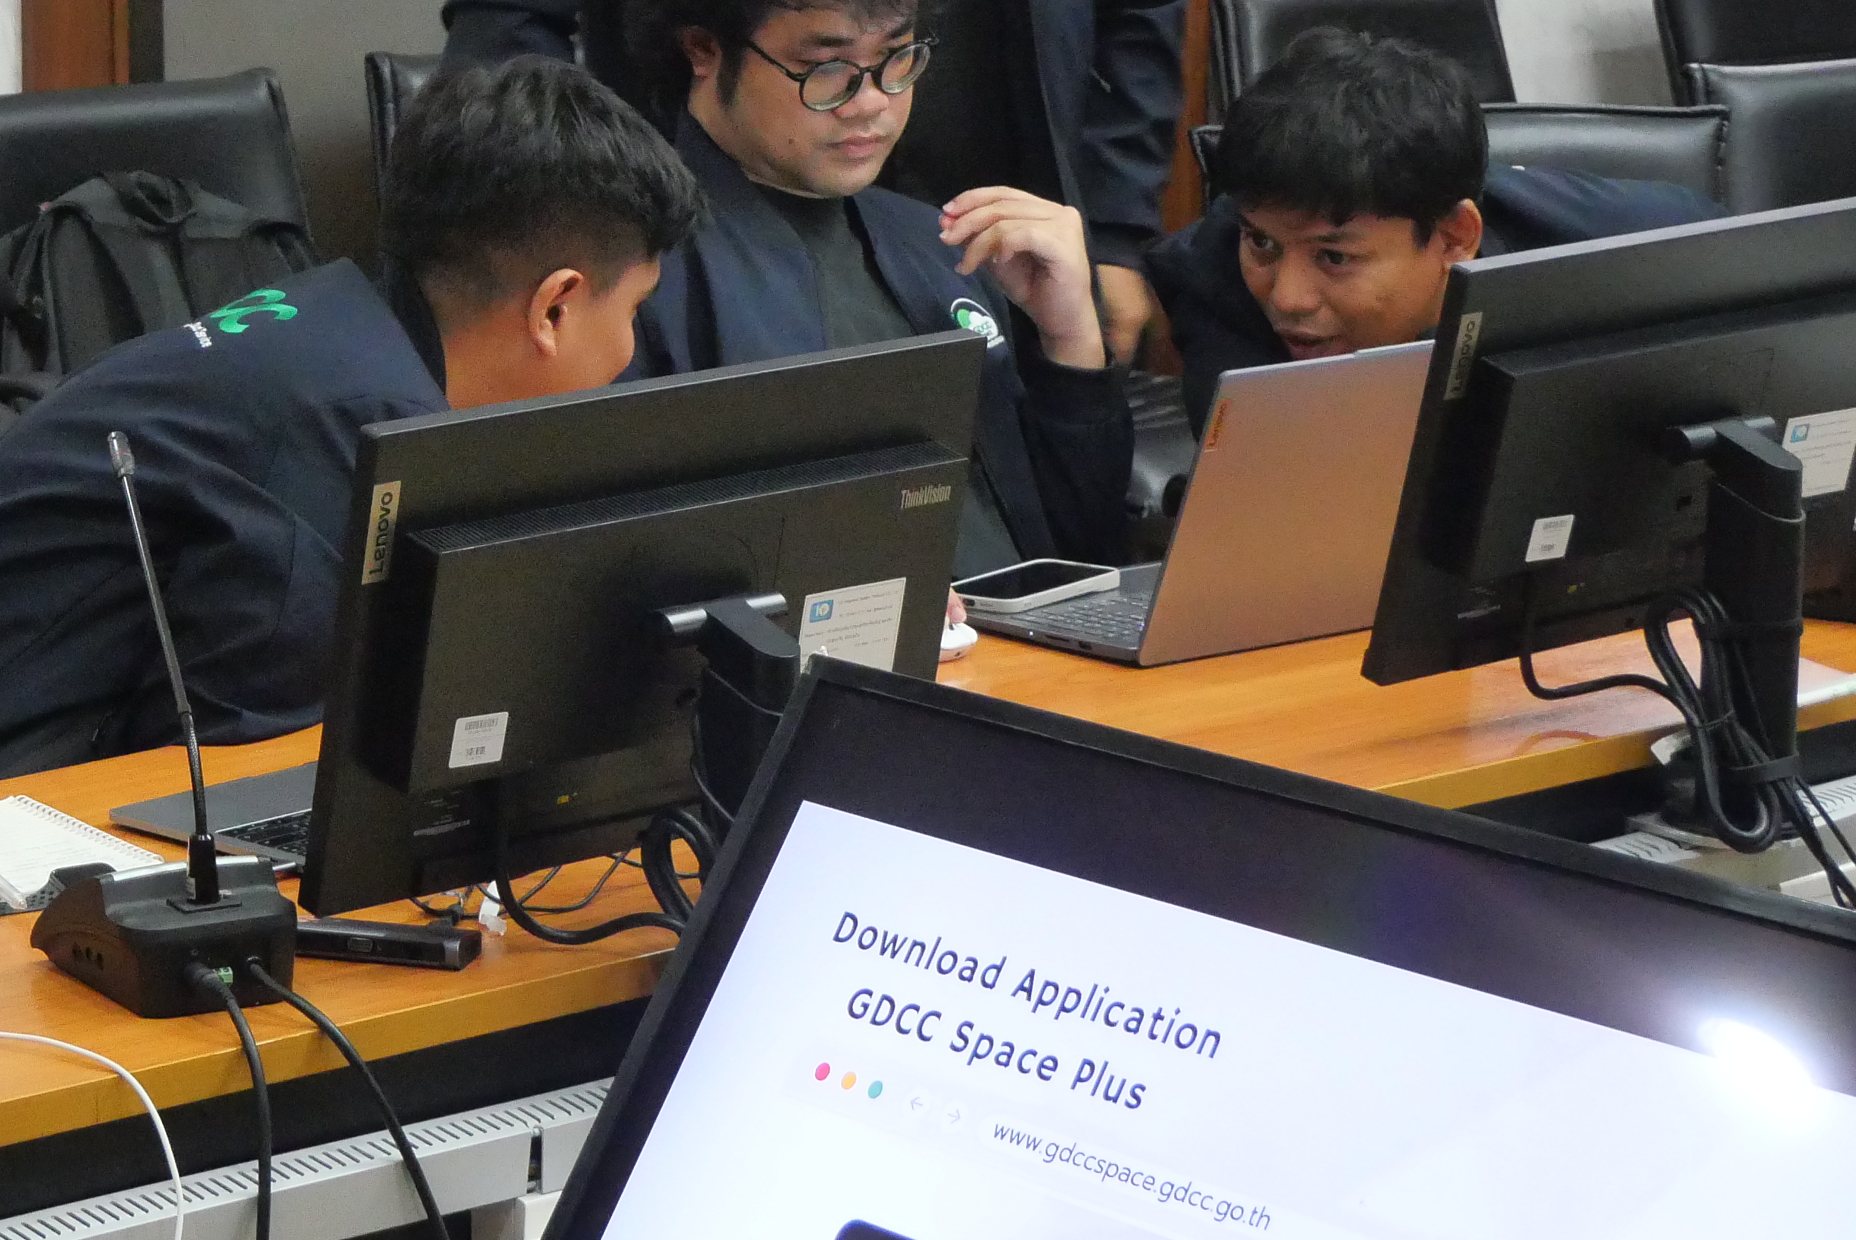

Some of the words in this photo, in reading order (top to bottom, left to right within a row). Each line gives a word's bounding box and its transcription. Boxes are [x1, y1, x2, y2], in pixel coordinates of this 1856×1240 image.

[369, 491, 393, 575] Lenovo
[901, 483, 951, 509] ThinkVision
[832, 911, 1007, 989] Download
[1011, 968, 1221, 1058] Application
[847, 988, 942, 1042] GDCC
[949, 1020, 1059, 1081] Space
[1070, 1058, 1147, 1109] Plus
[993, 1123, 1271, 1230] www.gdccspace.gdcc.go.th
